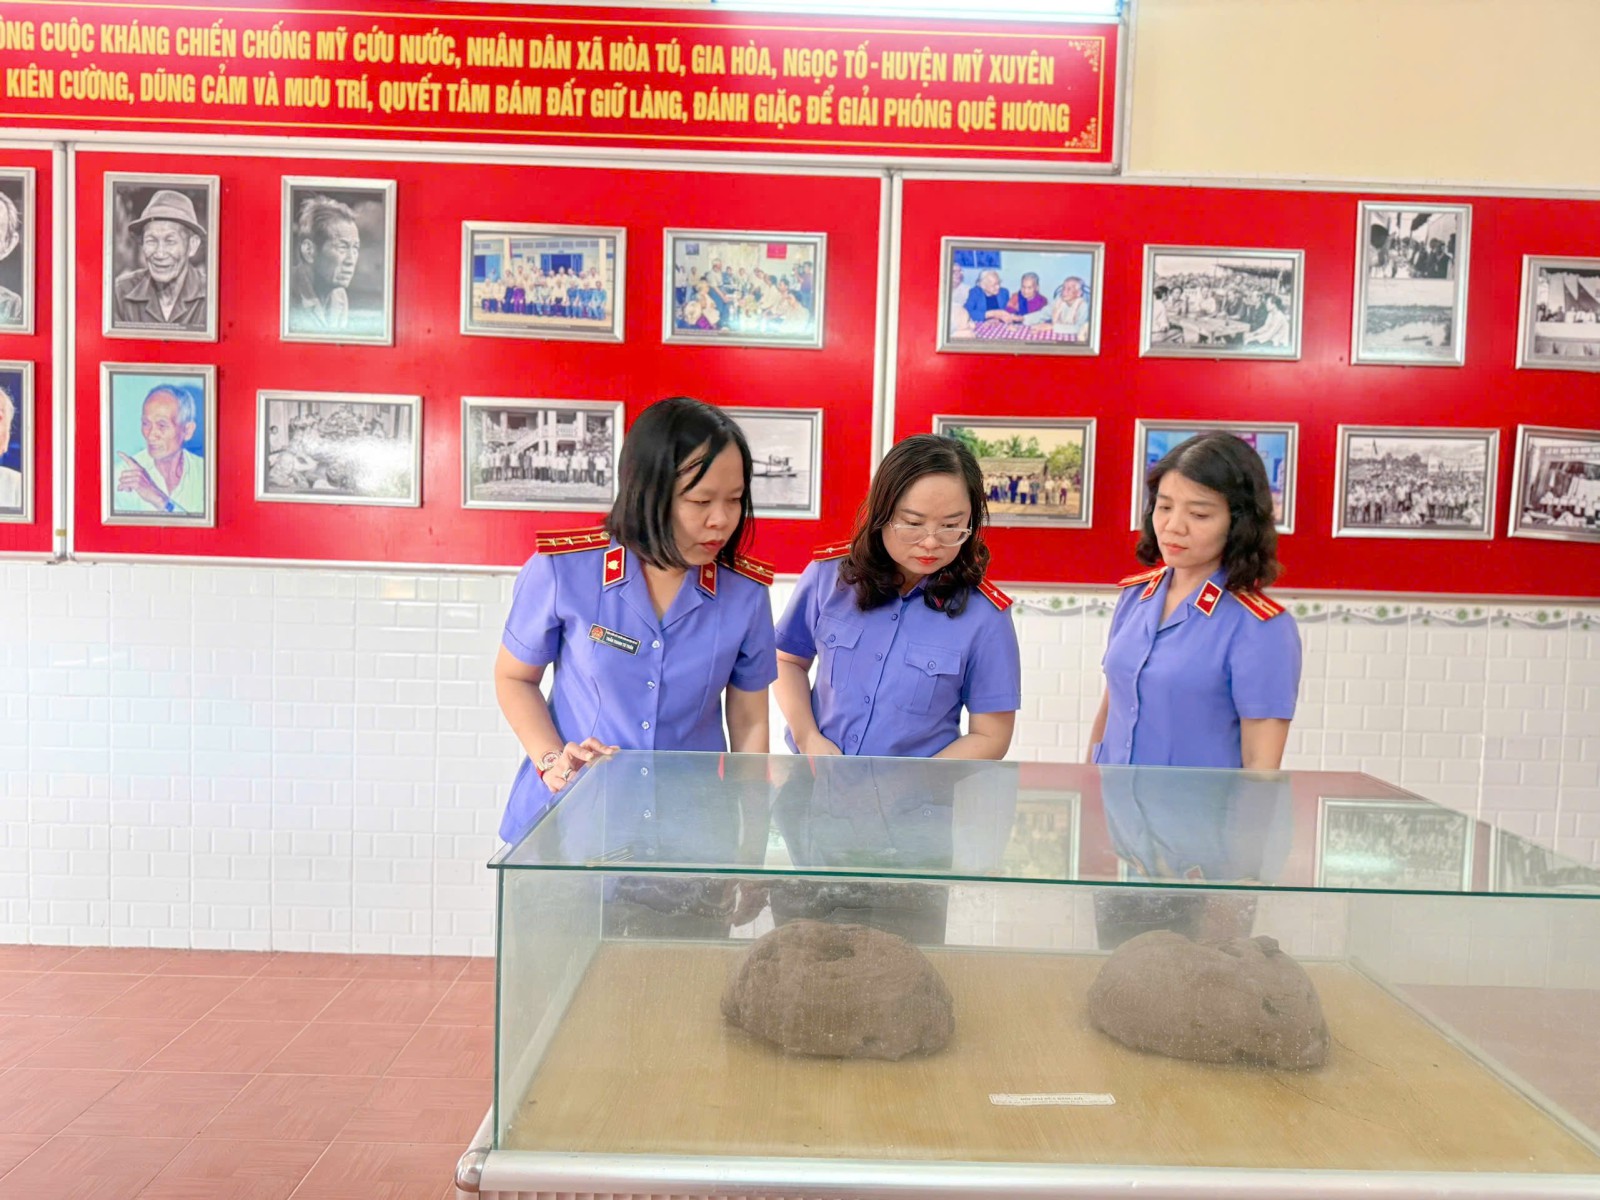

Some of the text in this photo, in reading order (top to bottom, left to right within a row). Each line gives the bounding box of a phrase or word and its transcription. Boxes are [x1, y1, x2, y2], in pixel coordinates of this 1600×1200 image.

[41, 17, 95, 59] CUỘC
[100, 20, 170, 55] KHÁNG
[176, 19, 236, 58] CHIẾN
[242, 20, 311, 60] CHỐNG
[317, 26, 348, 61] MỸ
[353, 25, 394, 63] CỨU
[400, 28, 461, 69] NƯỚC,
[467, 32, 524, 68] NHÂN
[529, 34, 571, 69] DÂN
[576, 36, 604, 70] XÃ
[610, 36, 650, 72] HÒA
[655, 38, 686, 76] TÚ,
[692, 45, 725, 74] GIA
[731, 40, 776, 79] HÒA,
[783, 47, 838, 84] NGỌC
[953, 49, 983, 82] MỸ
[989, 51, 1054, 84] XUYÊN
[7, 63, 1069, 132] KIÊN CƯỜNG, DŨNG CẢM VÀ MƯU TRÍ, QUYẾT TÂM BÁM ĐẤT GIỮ LÀNG, ĐÁNH GIẶC ĐỂ GIẢI PHÓNG QUÊ HƯƠNG
